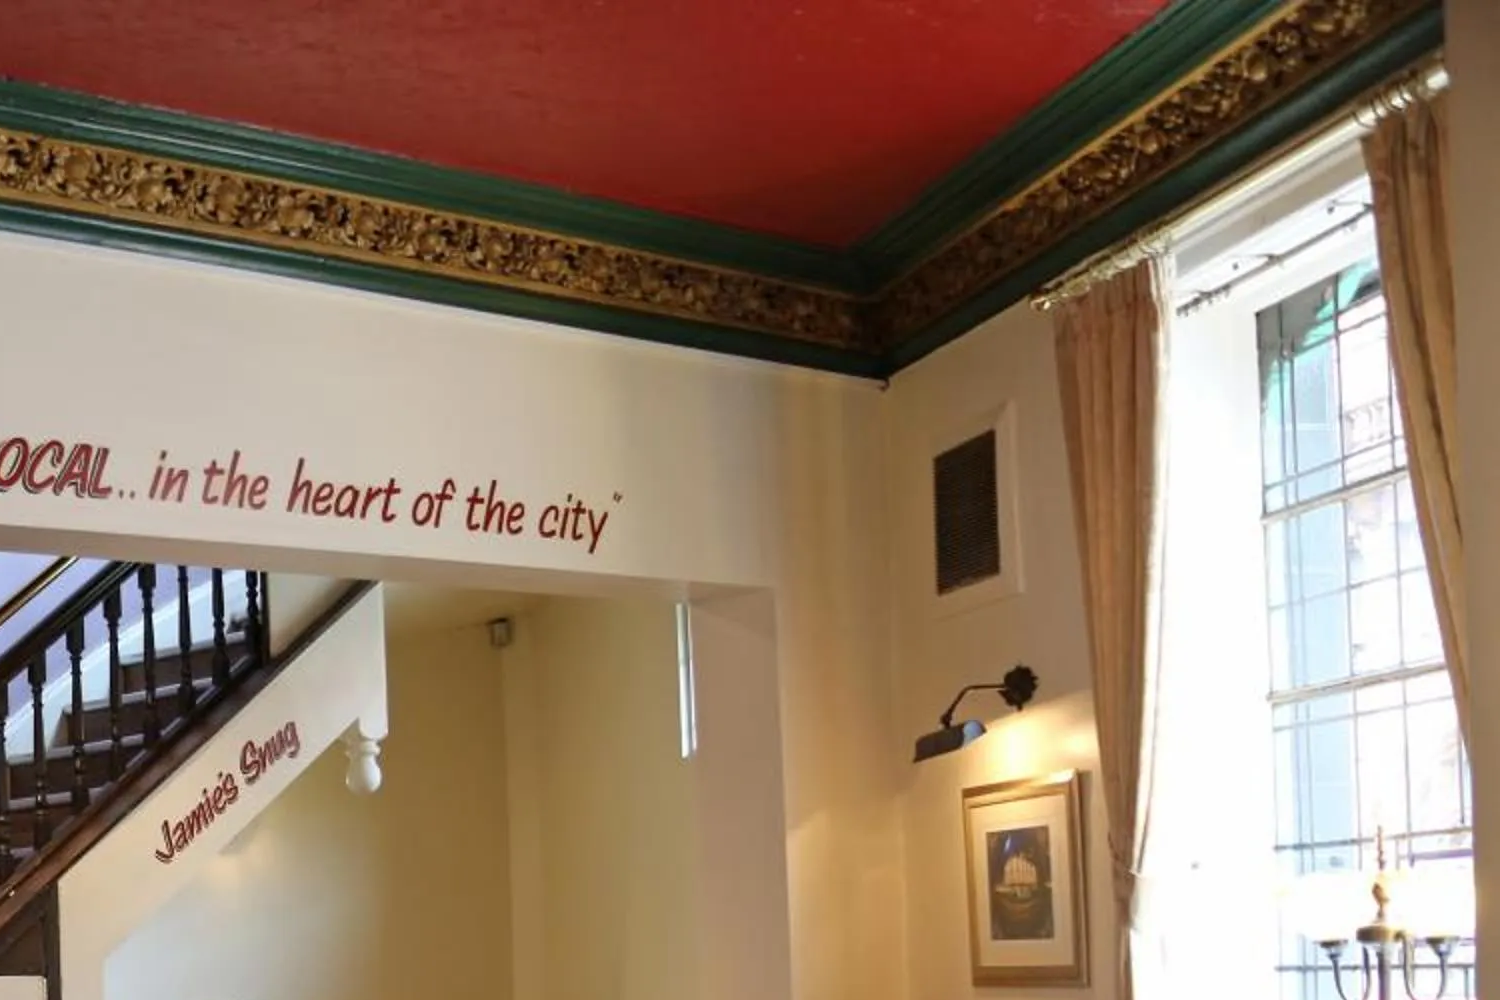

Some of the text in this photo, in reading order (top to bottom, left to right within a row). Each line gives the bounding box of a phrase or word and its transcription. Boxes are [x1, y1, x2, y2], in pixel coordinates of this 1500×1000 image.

[148, 450, 189, 503] in
[202, 450, 270, 511] the
[286, 457, 401, 523] heart
[411, 477, 457, 529] of
[465, 479, 526, 536] the
[155, 720, 301, 864] Jamie's Snug
